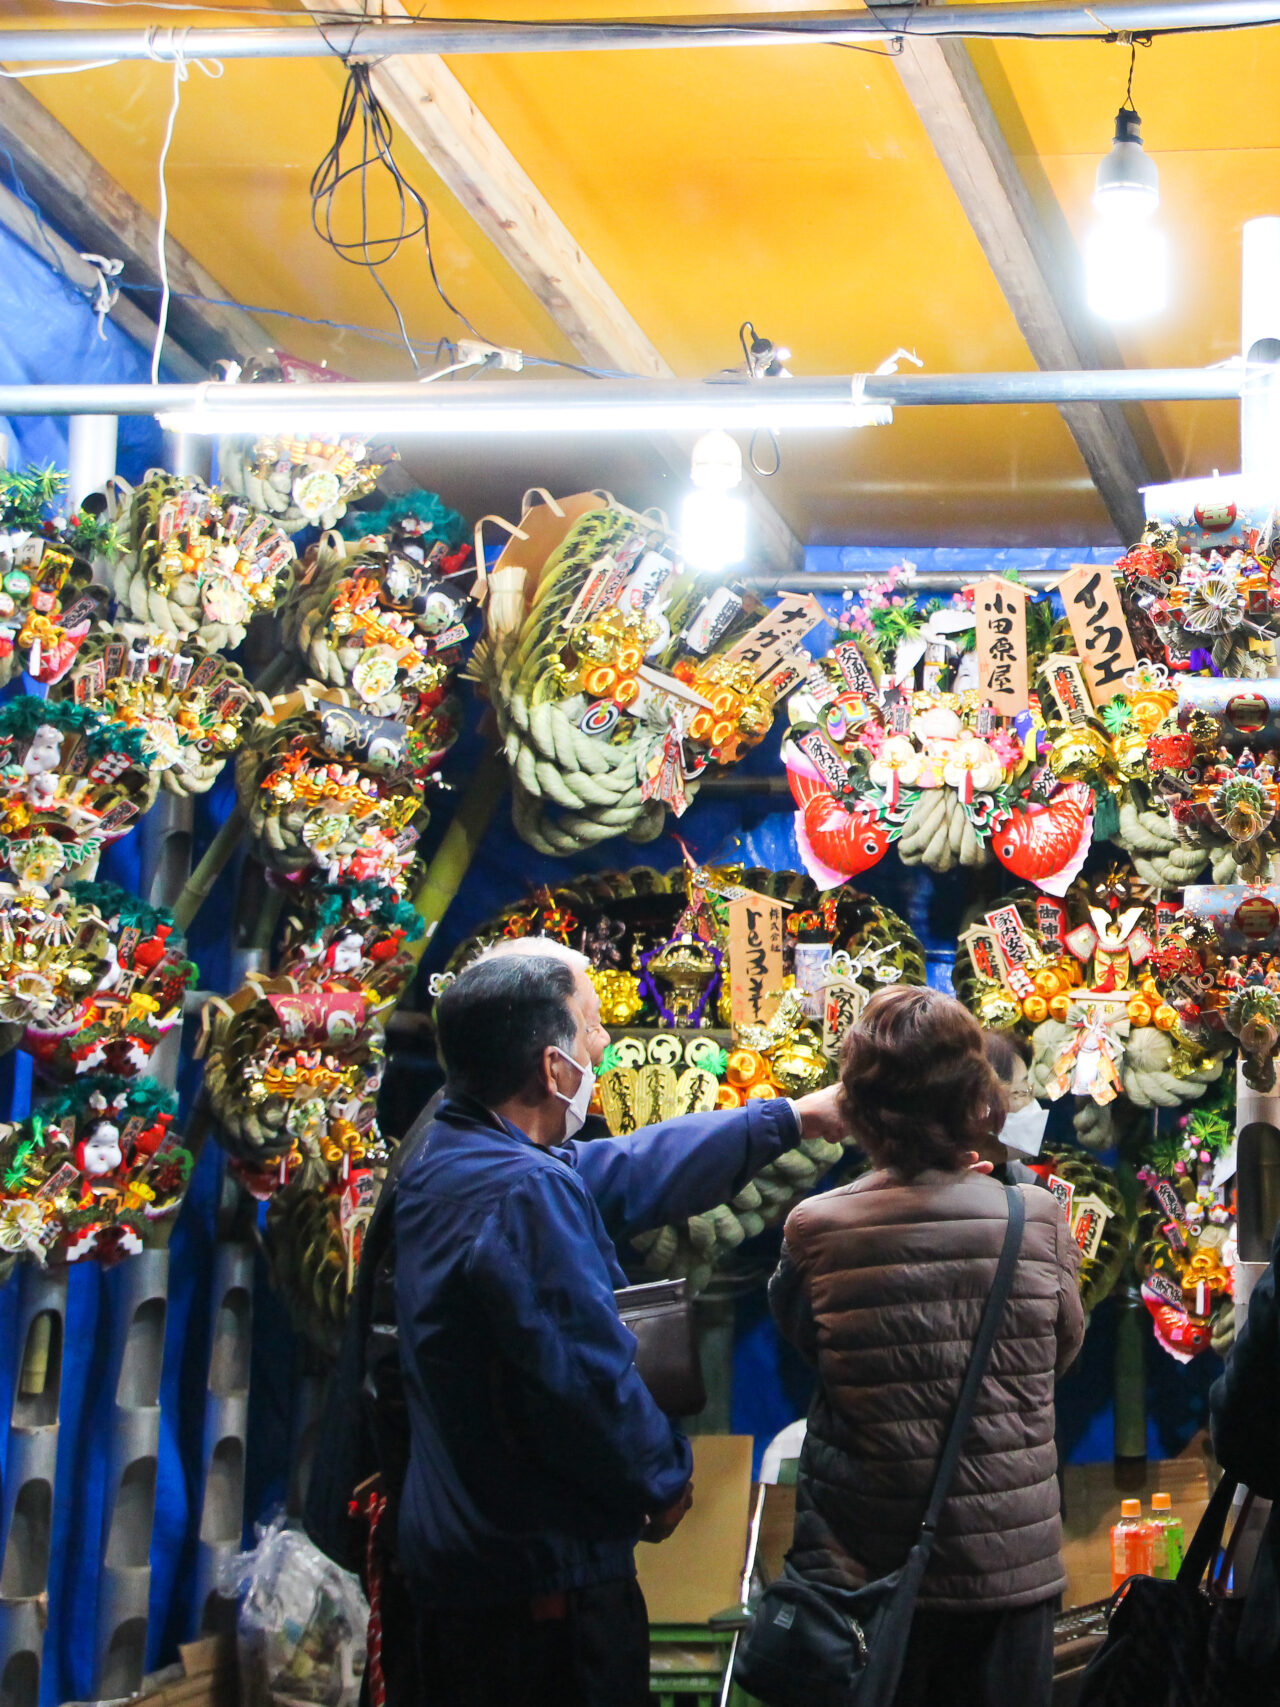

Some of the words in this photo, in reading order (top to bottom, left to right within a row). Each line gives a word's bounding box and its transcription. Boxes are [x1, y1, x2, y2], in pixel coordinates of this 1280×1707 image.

[985, 593, 1017, 695] 小田原屋
[1074, 572, 1135, 687] イノウエ
[995, 911, 1028, 965] 家内安全
